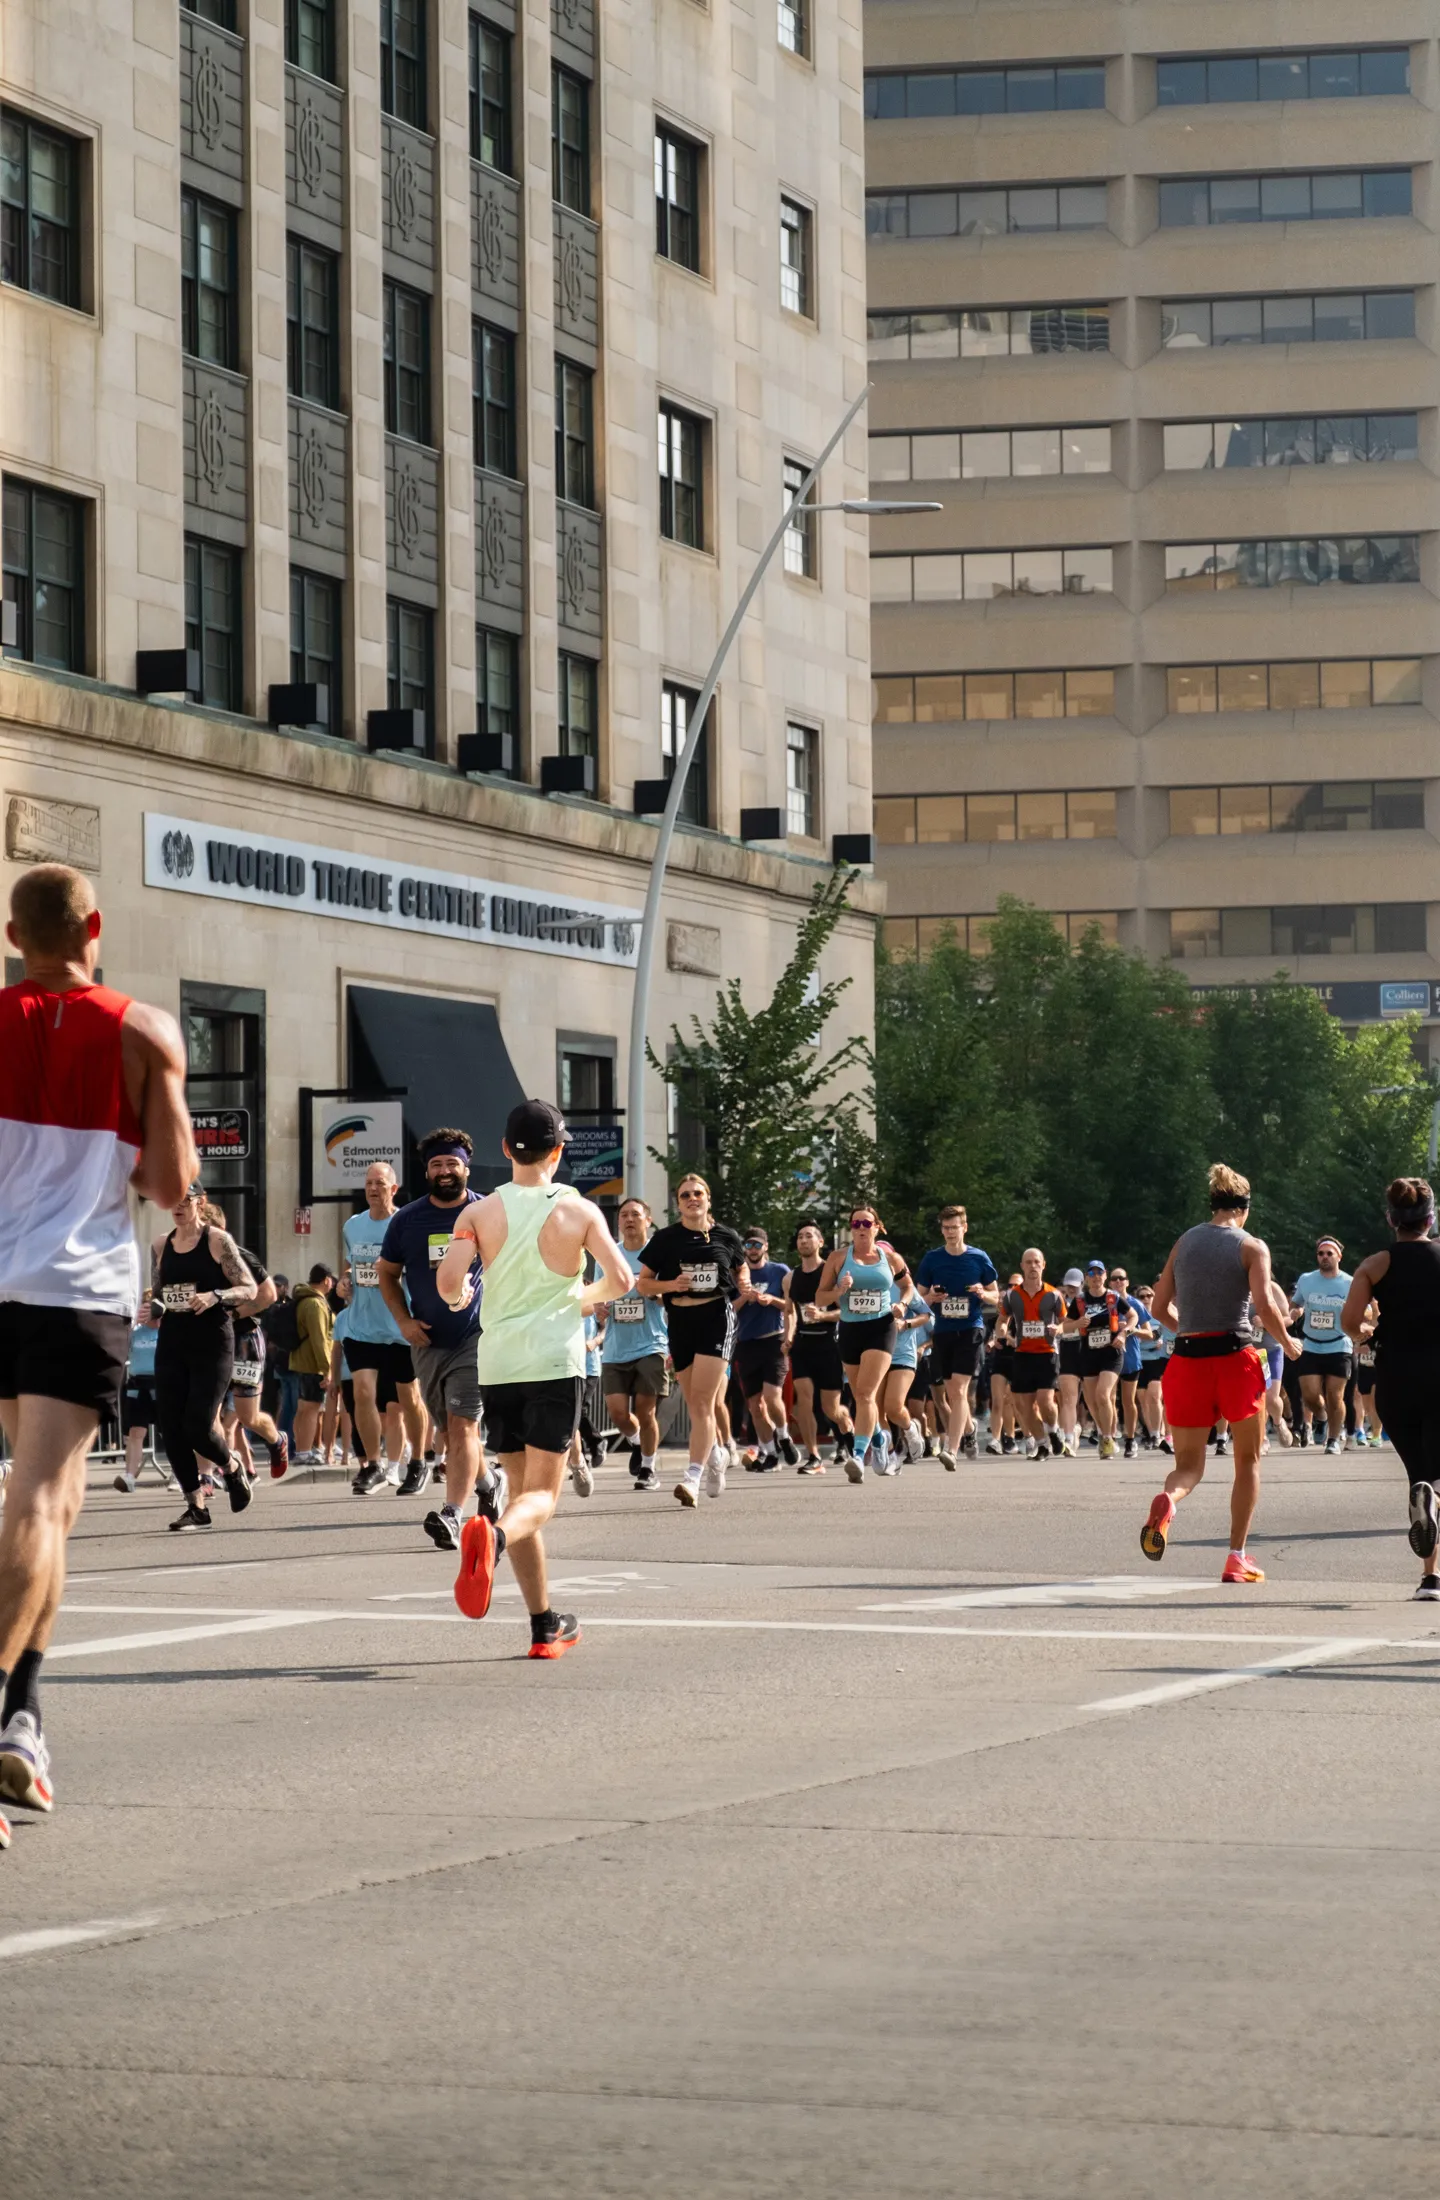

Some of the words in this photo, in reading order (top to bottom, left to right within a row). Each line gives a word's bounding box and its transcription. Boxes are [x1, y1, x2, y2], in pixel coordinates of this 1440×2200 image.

[207, 840, 305, 896] WORLD
[312, 860, 392, 912] TRADE
[399, 878, 485, 929] CENTRE
[1386, 990, 1424, 1000] Colliers
[610, 1132, 617, 1140] &
[207, 1145, 246, 1156] HOUSE
[343, 1146, 401, 1156] Edmonton
[359, 1271, 378, 1279] 5897
[854, 1298, 875, 1306] 5978
[619, 1307, 638, 1315] 5737
[944, 1303, 965, 1311] 6344
[236, 1368, 257, 1378] 5746
